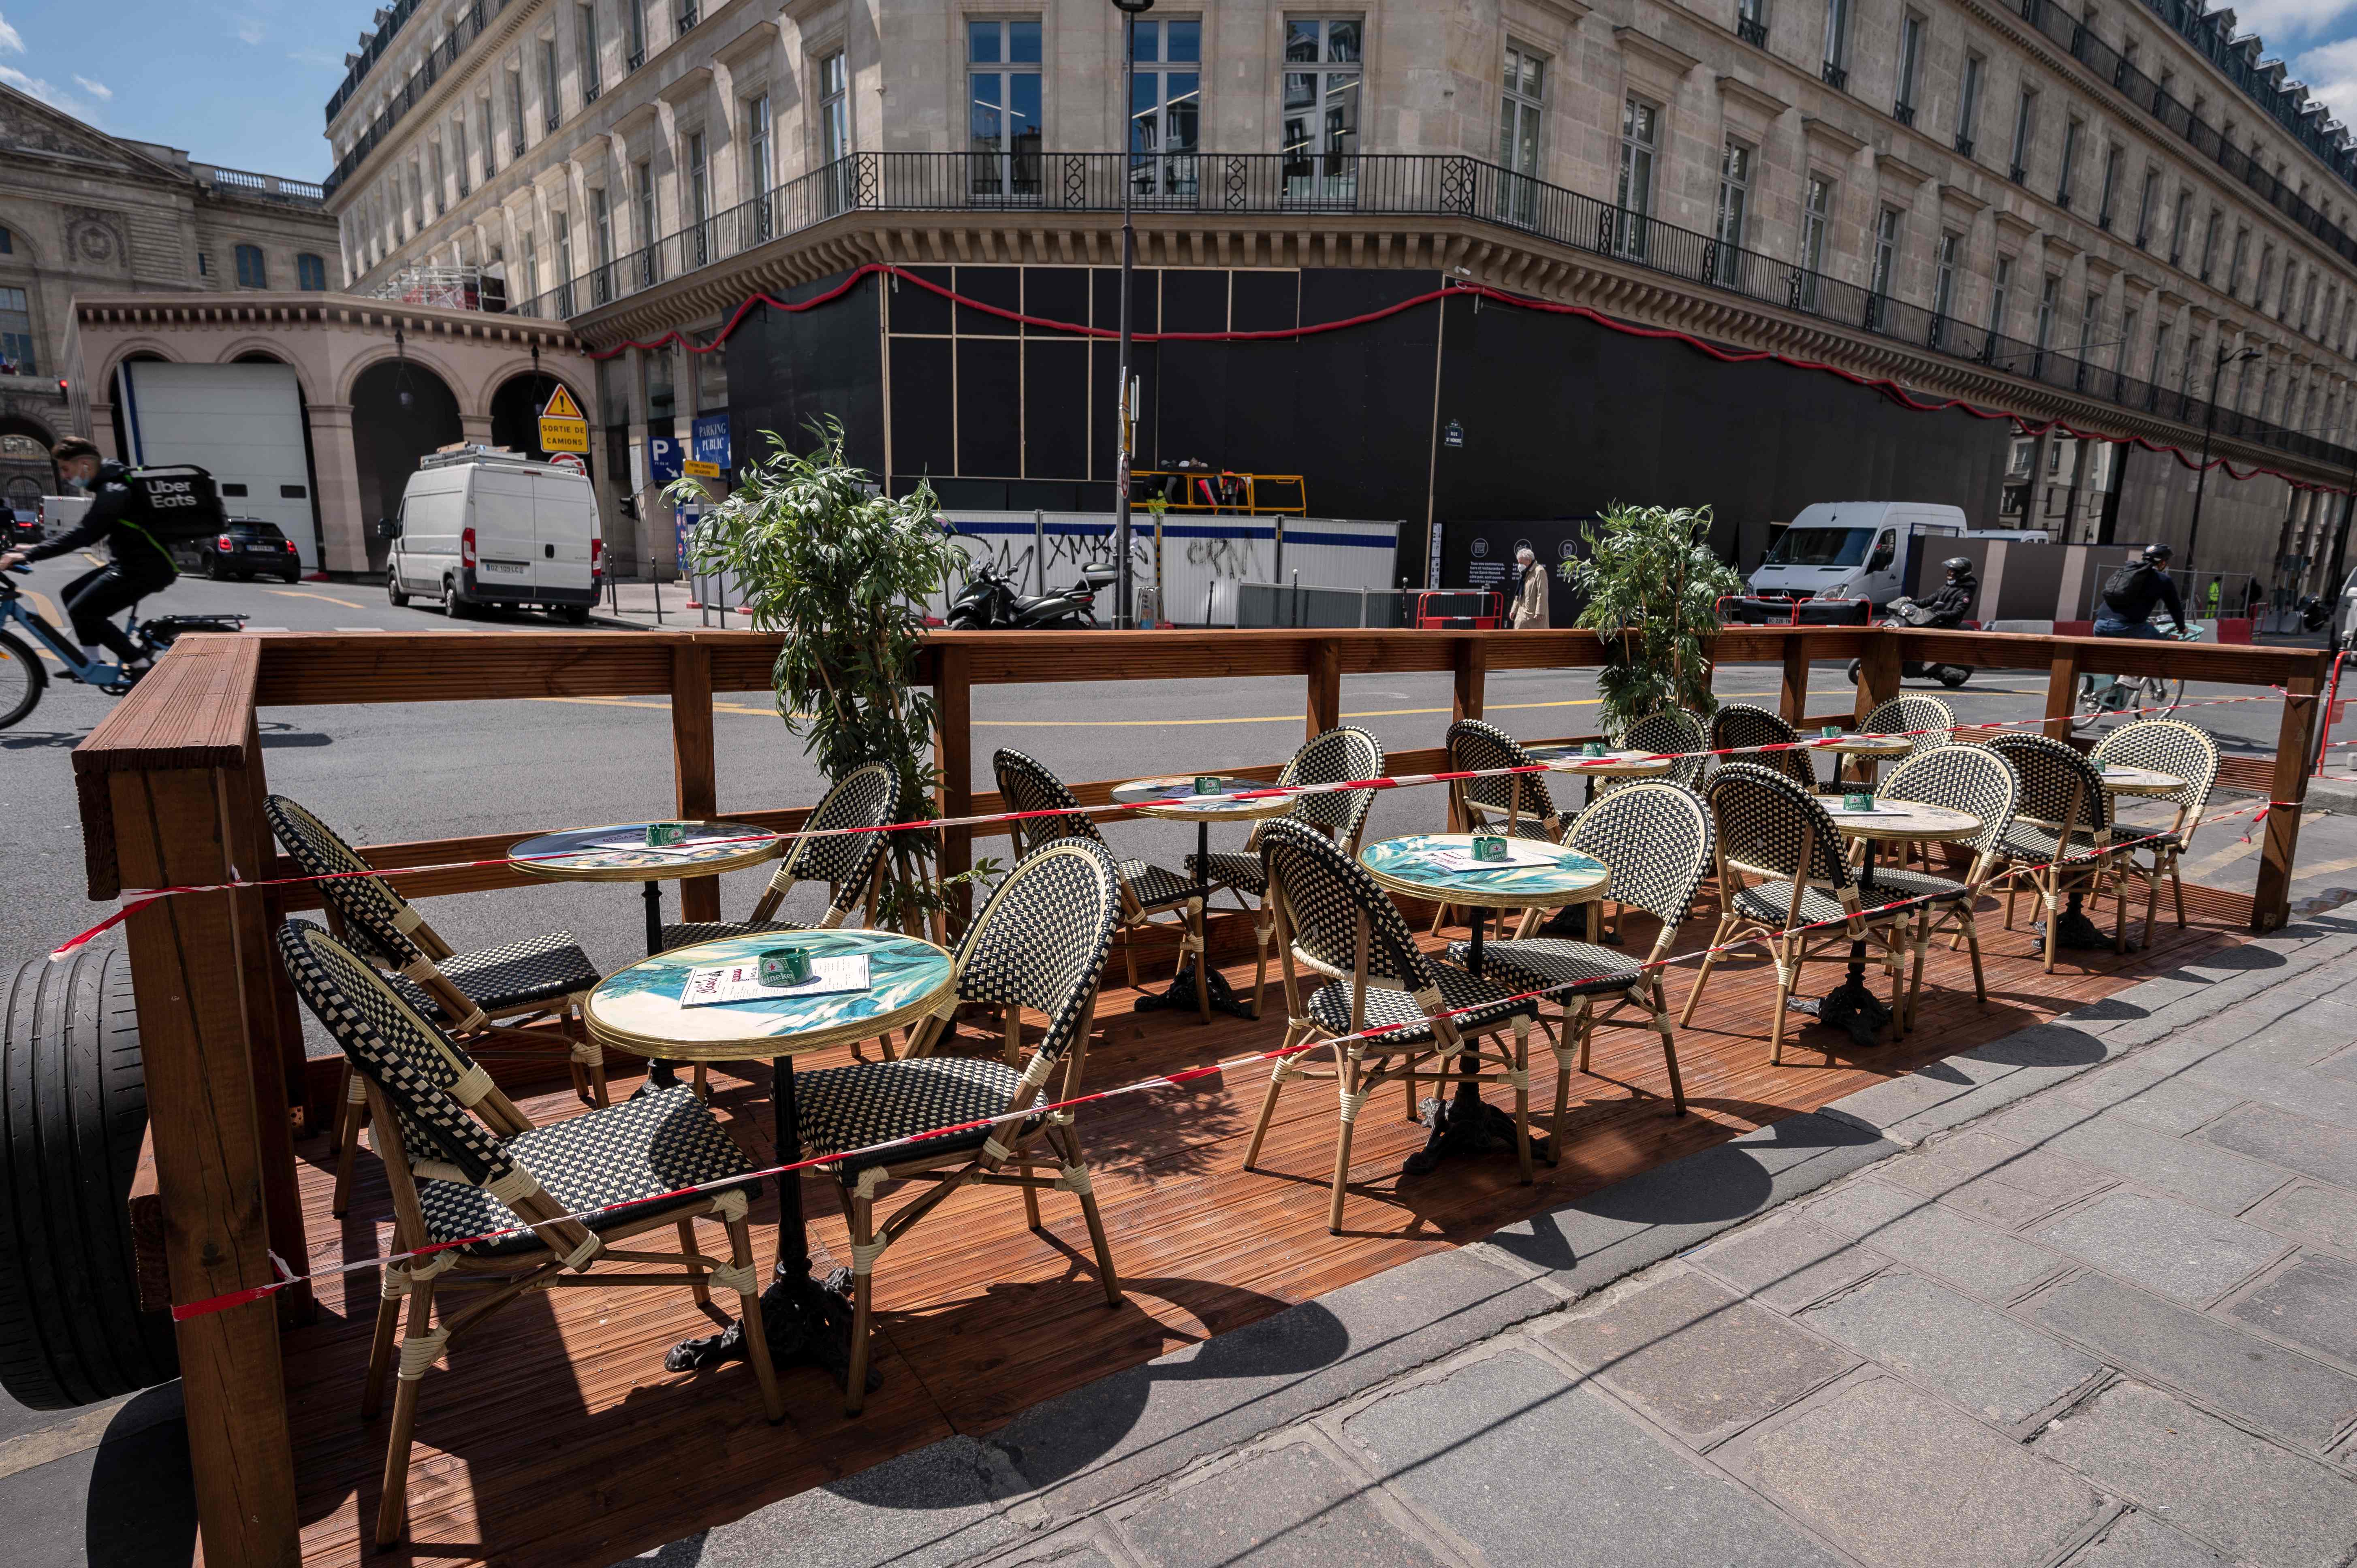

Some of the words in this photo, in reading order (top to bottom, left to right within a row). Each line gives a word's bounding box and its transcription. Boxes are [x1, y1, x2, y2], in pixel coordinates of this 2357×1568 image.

[699, 422, 726, 437] PARKING
[652, 440, 669, 461] P
[702, 438, 724, 451] PUBLIC
[146, 480, 191, 494] Uber
[150, 495, 197, 508] Eats
